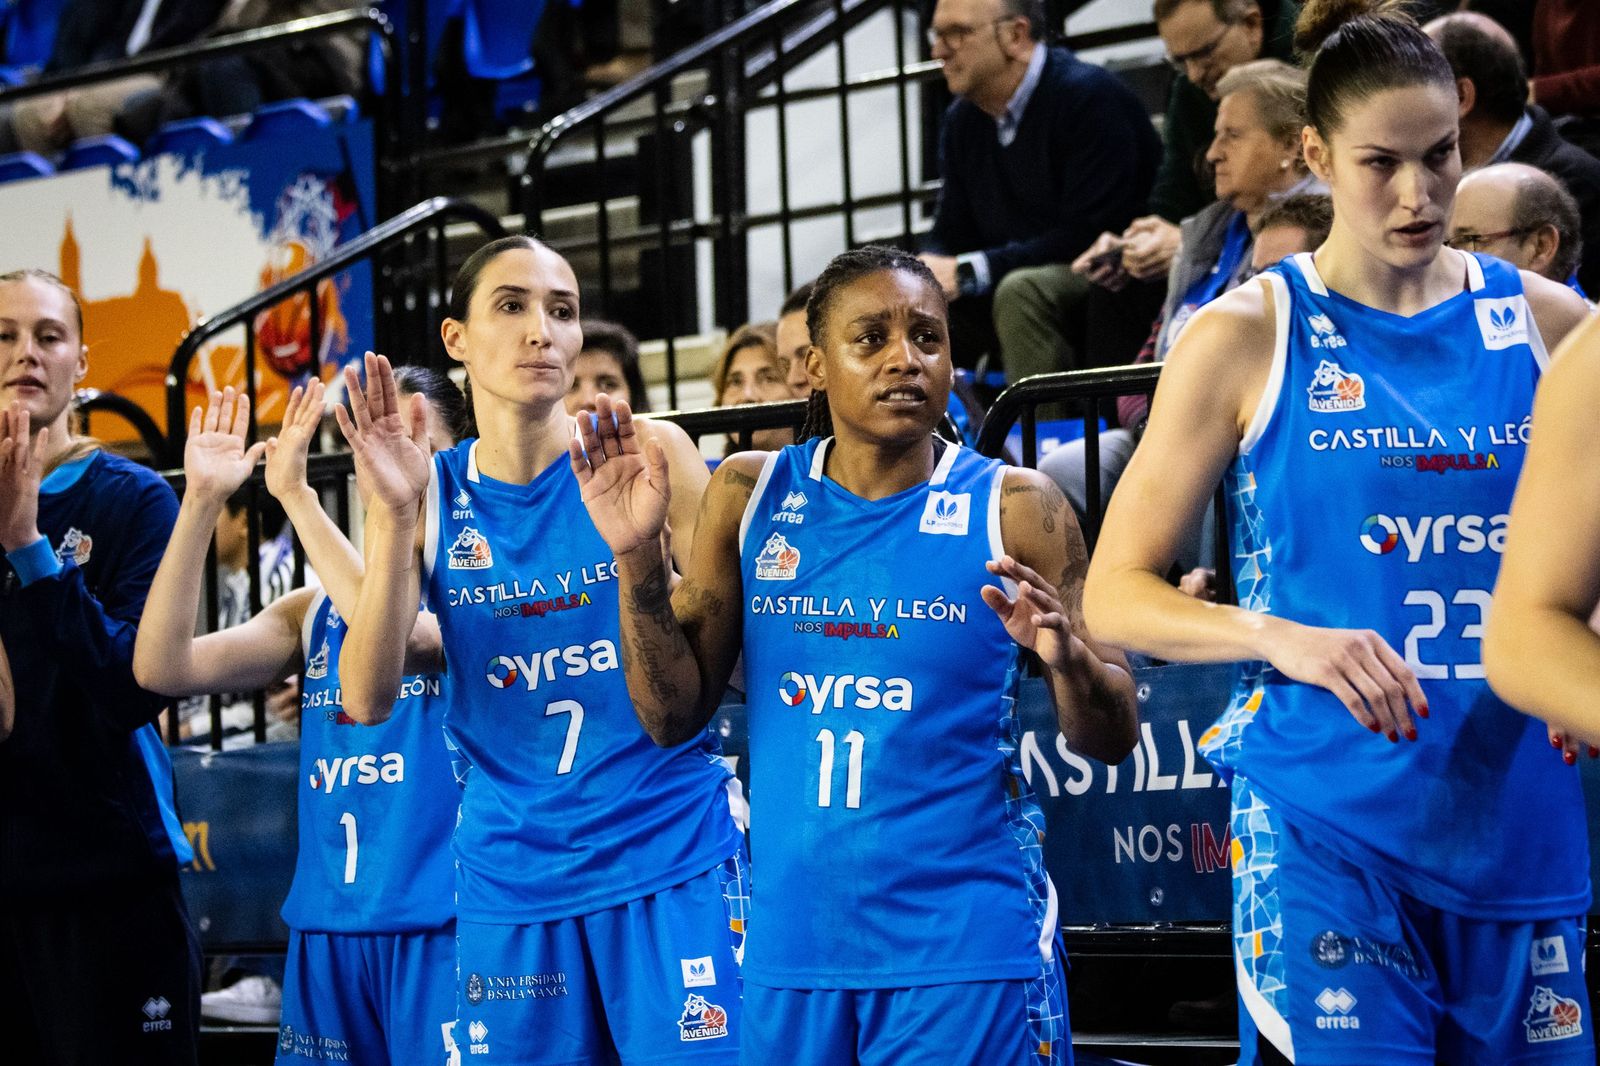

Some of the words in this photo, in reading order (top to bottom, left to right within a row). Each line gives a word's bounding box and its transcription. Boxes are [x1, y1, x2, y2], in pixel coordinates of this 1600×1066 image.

[1308, 426, 1447, 451] CASTILLA
[1458, 426, 1477, 451] Y
[1488, 415, 1533, 445] LEÓ
[1380, 455, 1414, 468] NOS
[448, 579, 547, 607] CASTILLA
[555, 571, 572, 594] Y
[580, 558, 618, 585] LEÓ
[493, 605, 520, 619] NOS
[751, 595, 855, 617] CASTILLA
[869, 598, 887, 622] Y
[896, 595, 967, 623] LEÓN
[794, 622, 822, 633] NOS
[824, 622, 900, 640] IMPULSA
[1402, 589, 1494, 680] 23
[396, 674, 440, 700] EÓN
[545, 699, 585, 775] 7
[815, 728, 865, 809] 11
[339, 812, 359, 884] 1
[1113, 823, 1184, 864] NOS
[142, 1018, 172, 1032] errea
[683, 1026, 726, 1039] AVENIDA
[1315, 1015, 1360, 1029] errea
[1530, 1024, 1580, 1039] AVENIDA
